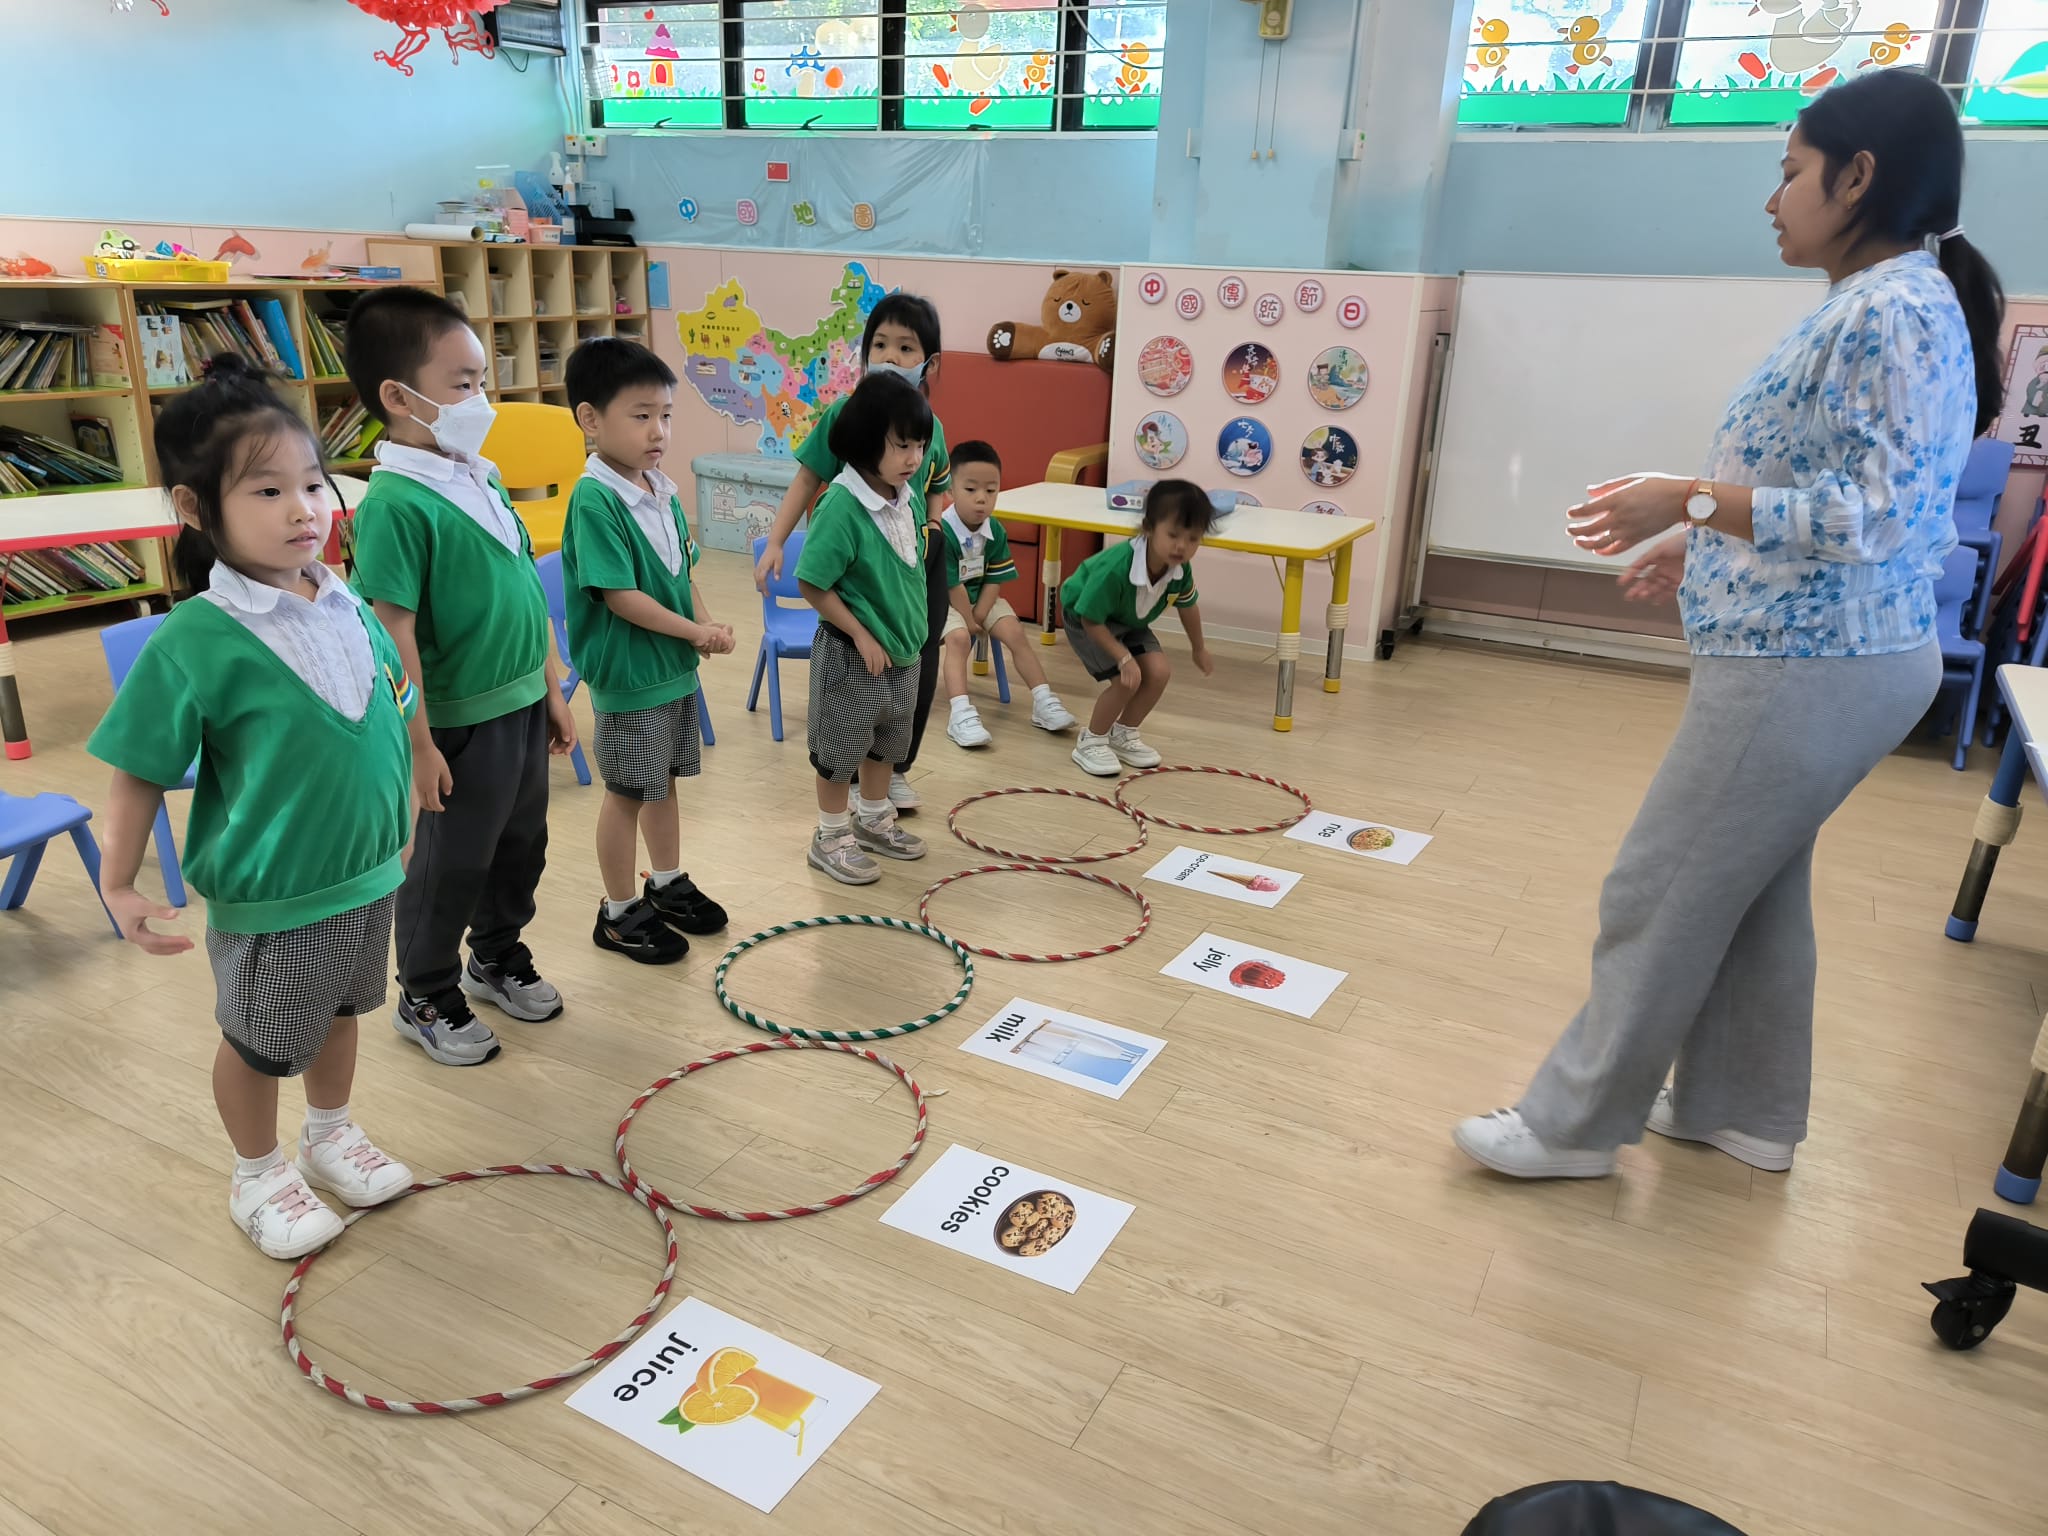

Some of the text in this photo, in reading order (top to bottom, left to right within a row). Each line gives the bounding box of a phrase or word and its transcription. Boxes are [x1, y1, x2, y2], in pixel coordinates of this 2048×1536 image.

[1144, 277, 1361, 322] 中國傳統節日
[2013, 424, 2042, 449] 丑
[1318, 822, 1343, 838] rice
[1174, 853, 1214, 881] ice-cream
[1193, 947, 1231, 972] jelly
[984, 1013, 1026, 1043] milk
[940, 1165, 1010, 1233] cookies
[613, 1331, 698, 1402] juice
